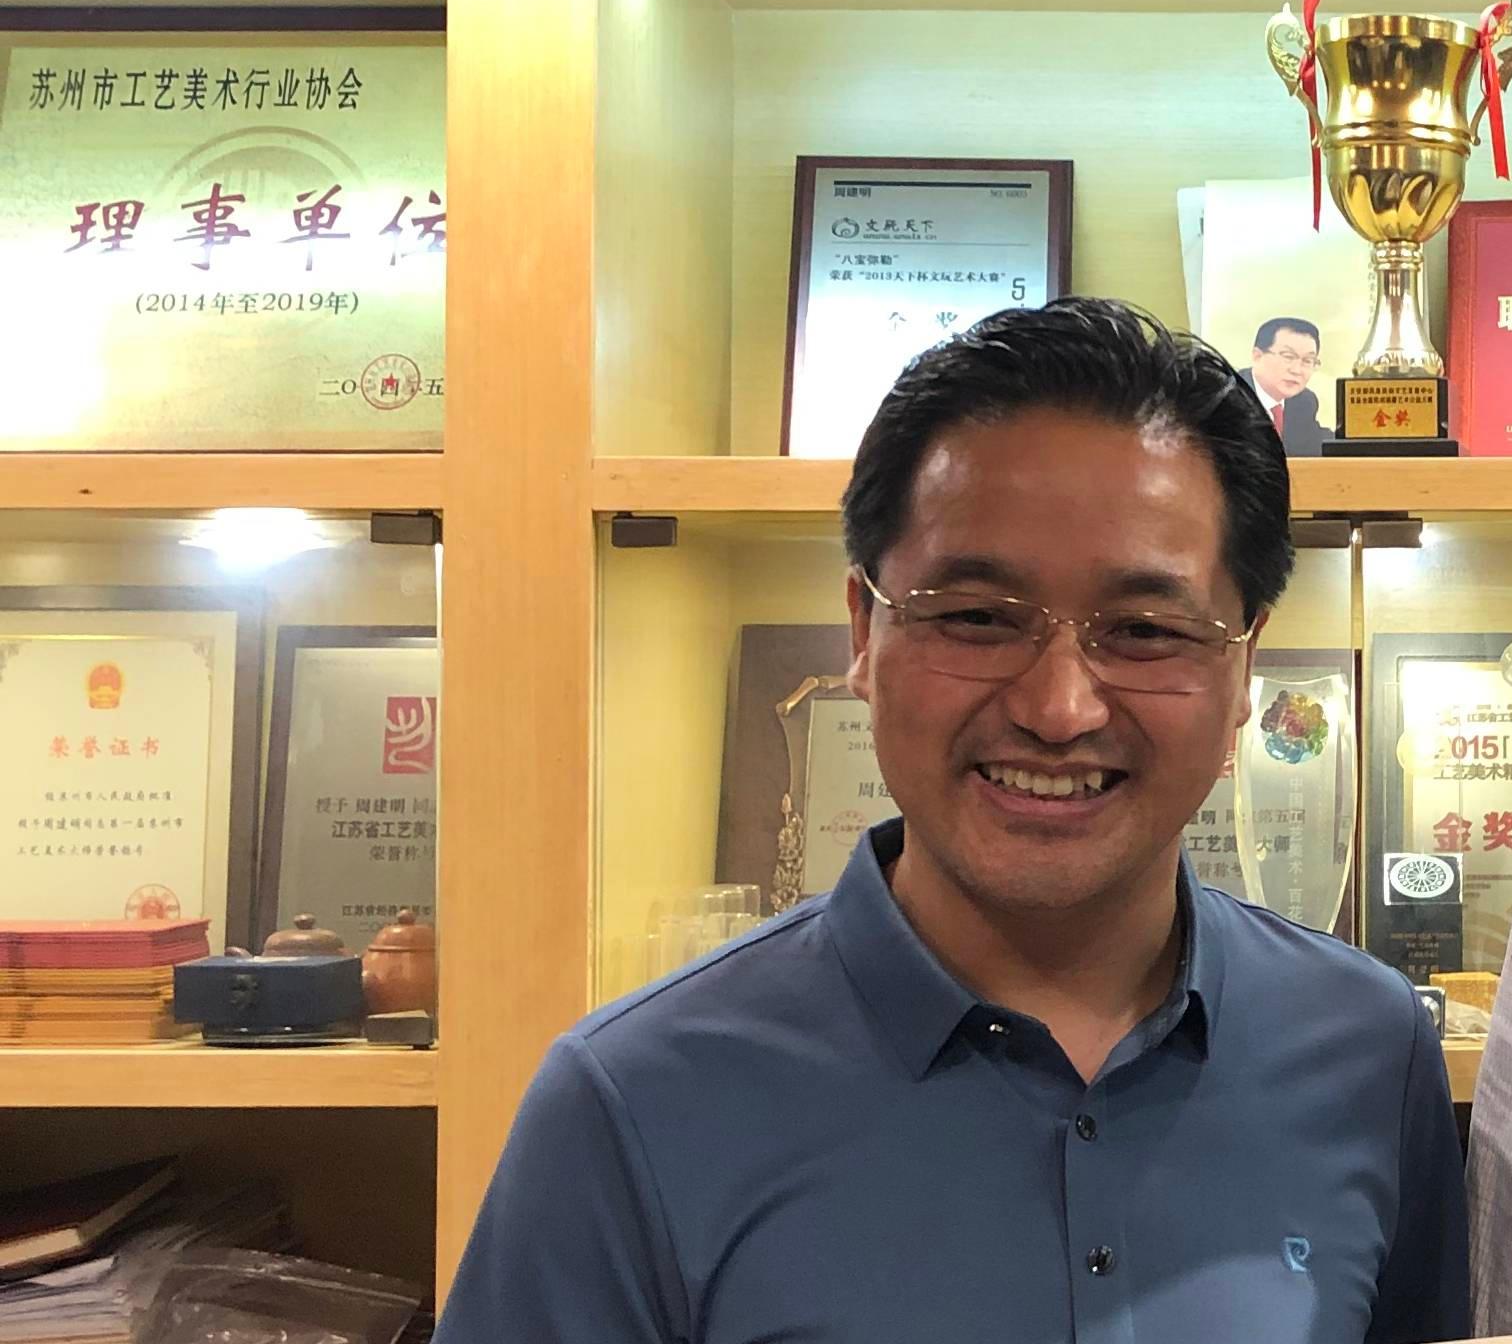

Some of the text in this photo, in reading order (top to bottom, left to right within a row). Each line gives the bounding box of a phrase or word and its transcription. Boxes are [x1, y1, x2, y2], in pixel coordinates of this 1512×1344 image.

[29, 67, 363, 111] 苏州市工艺美术行业协会
[135, 292, 360, 315] (2014年至2019年)
[50, 736, 160, 759] 荣誉证书
